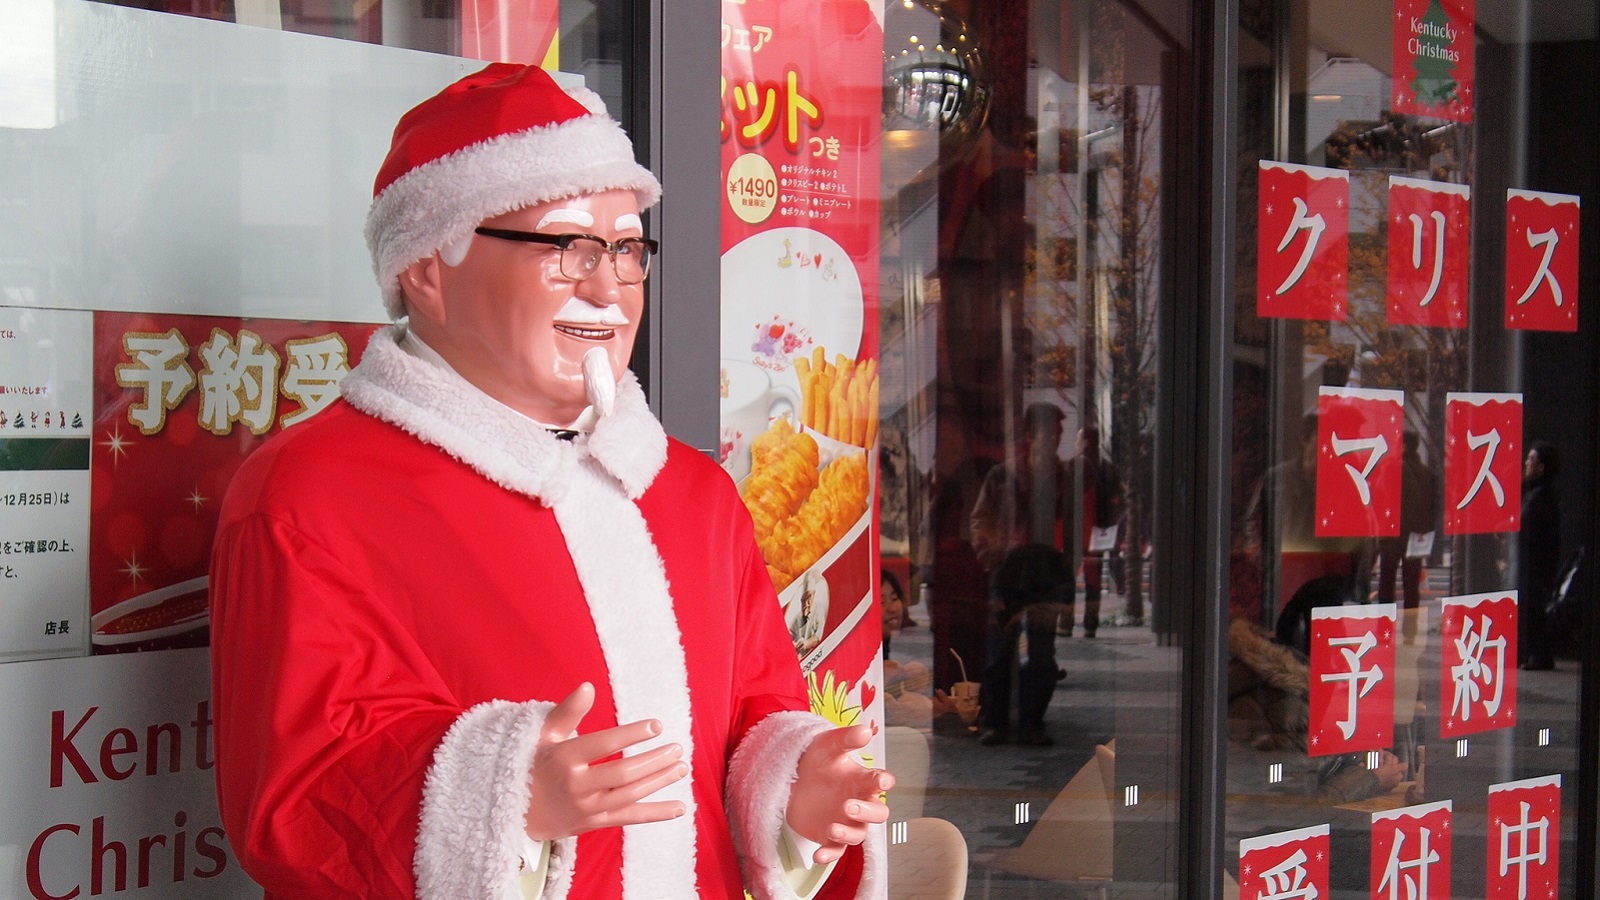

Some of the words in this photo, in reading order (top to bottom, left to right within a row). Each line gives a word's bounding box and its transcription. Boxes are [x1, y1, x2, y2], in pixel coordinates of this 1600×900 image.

[1410, 17, 1458, 43] Kentucky
[1408, 38, 1460, 62] Christmas
[720, 67, 820, 146] ット
[808, 135, 841, 161] つき
[729, 176, 775, 199] ¥1490
[115, 327, 349, 436] 予約受
[0, 491, 70, 507] 12月25日)は
[0, 539, 74, 554] をご確認の上、
[44, 620, 70, 635] 店長
[50, 700, 214, 788] Kent
[26, 811, 228, 900] Chris
